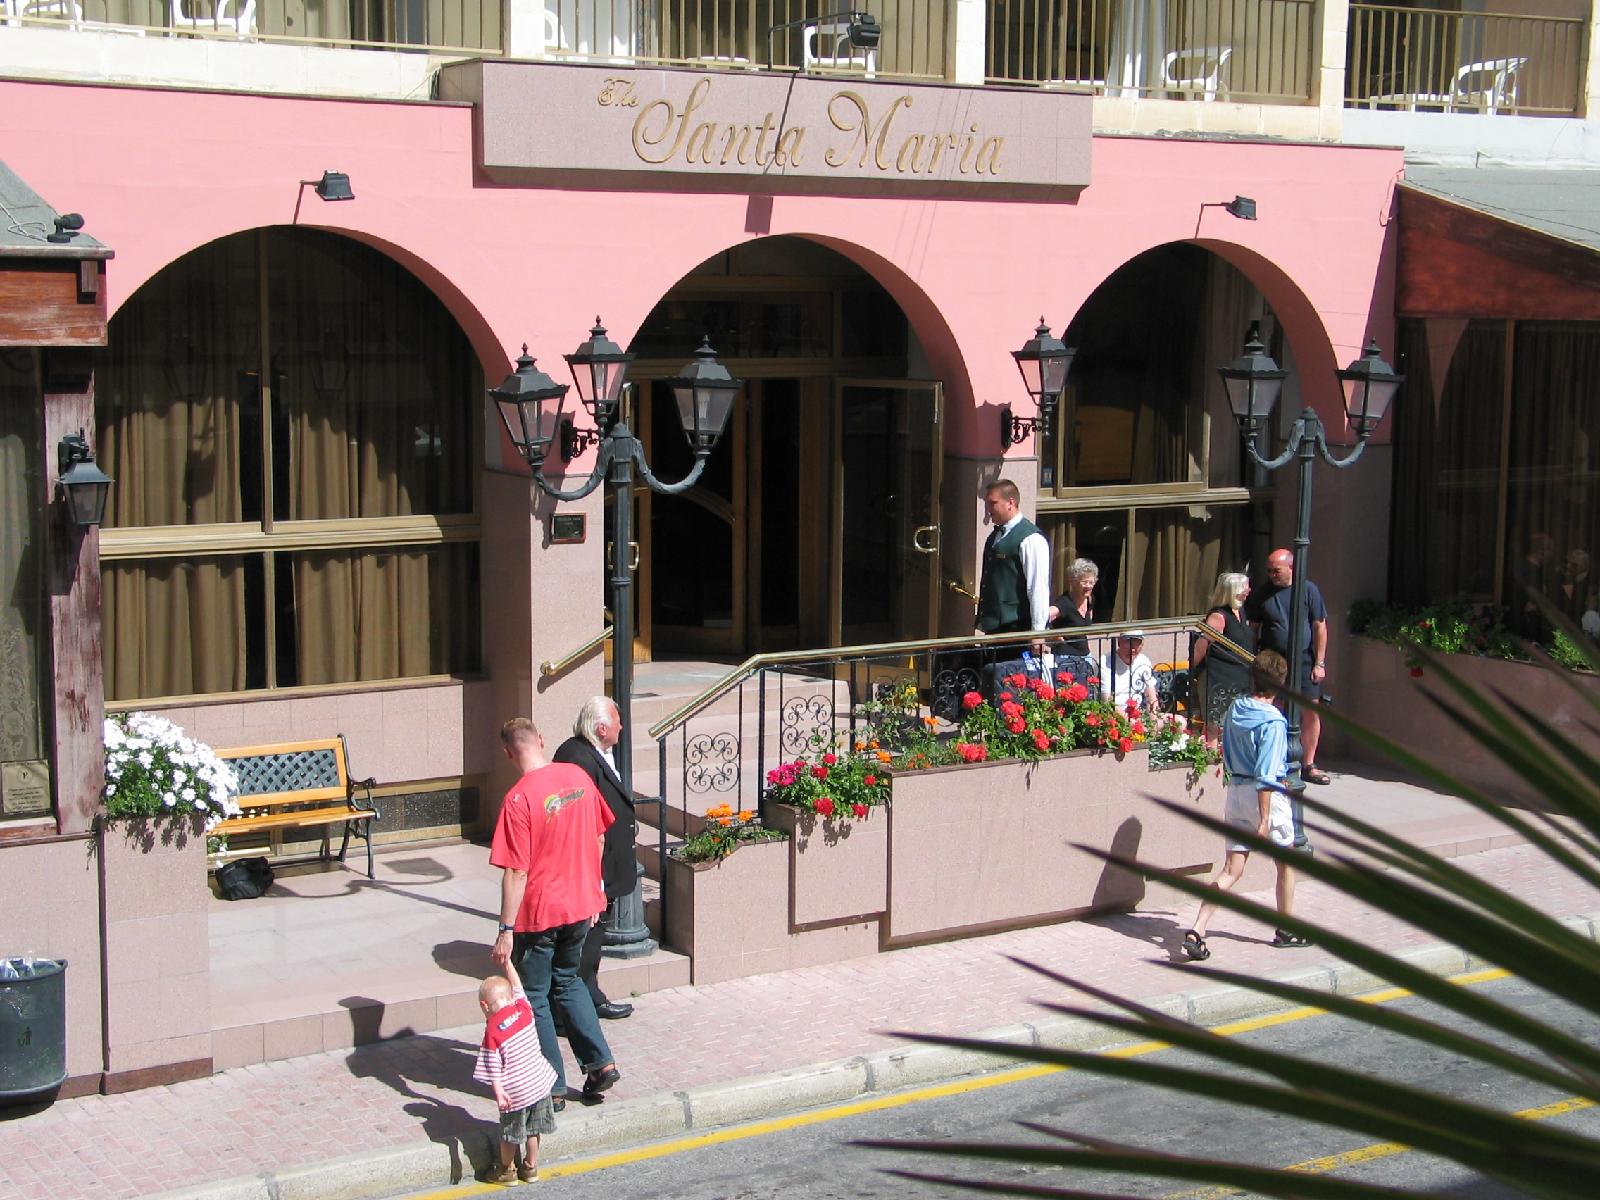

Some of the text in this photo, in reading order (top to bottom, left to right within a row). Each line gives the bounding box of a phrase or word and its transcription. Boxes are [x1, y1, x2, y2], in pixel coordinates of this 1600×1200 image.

[598, 77, 1004, 174] The Santa Maria
